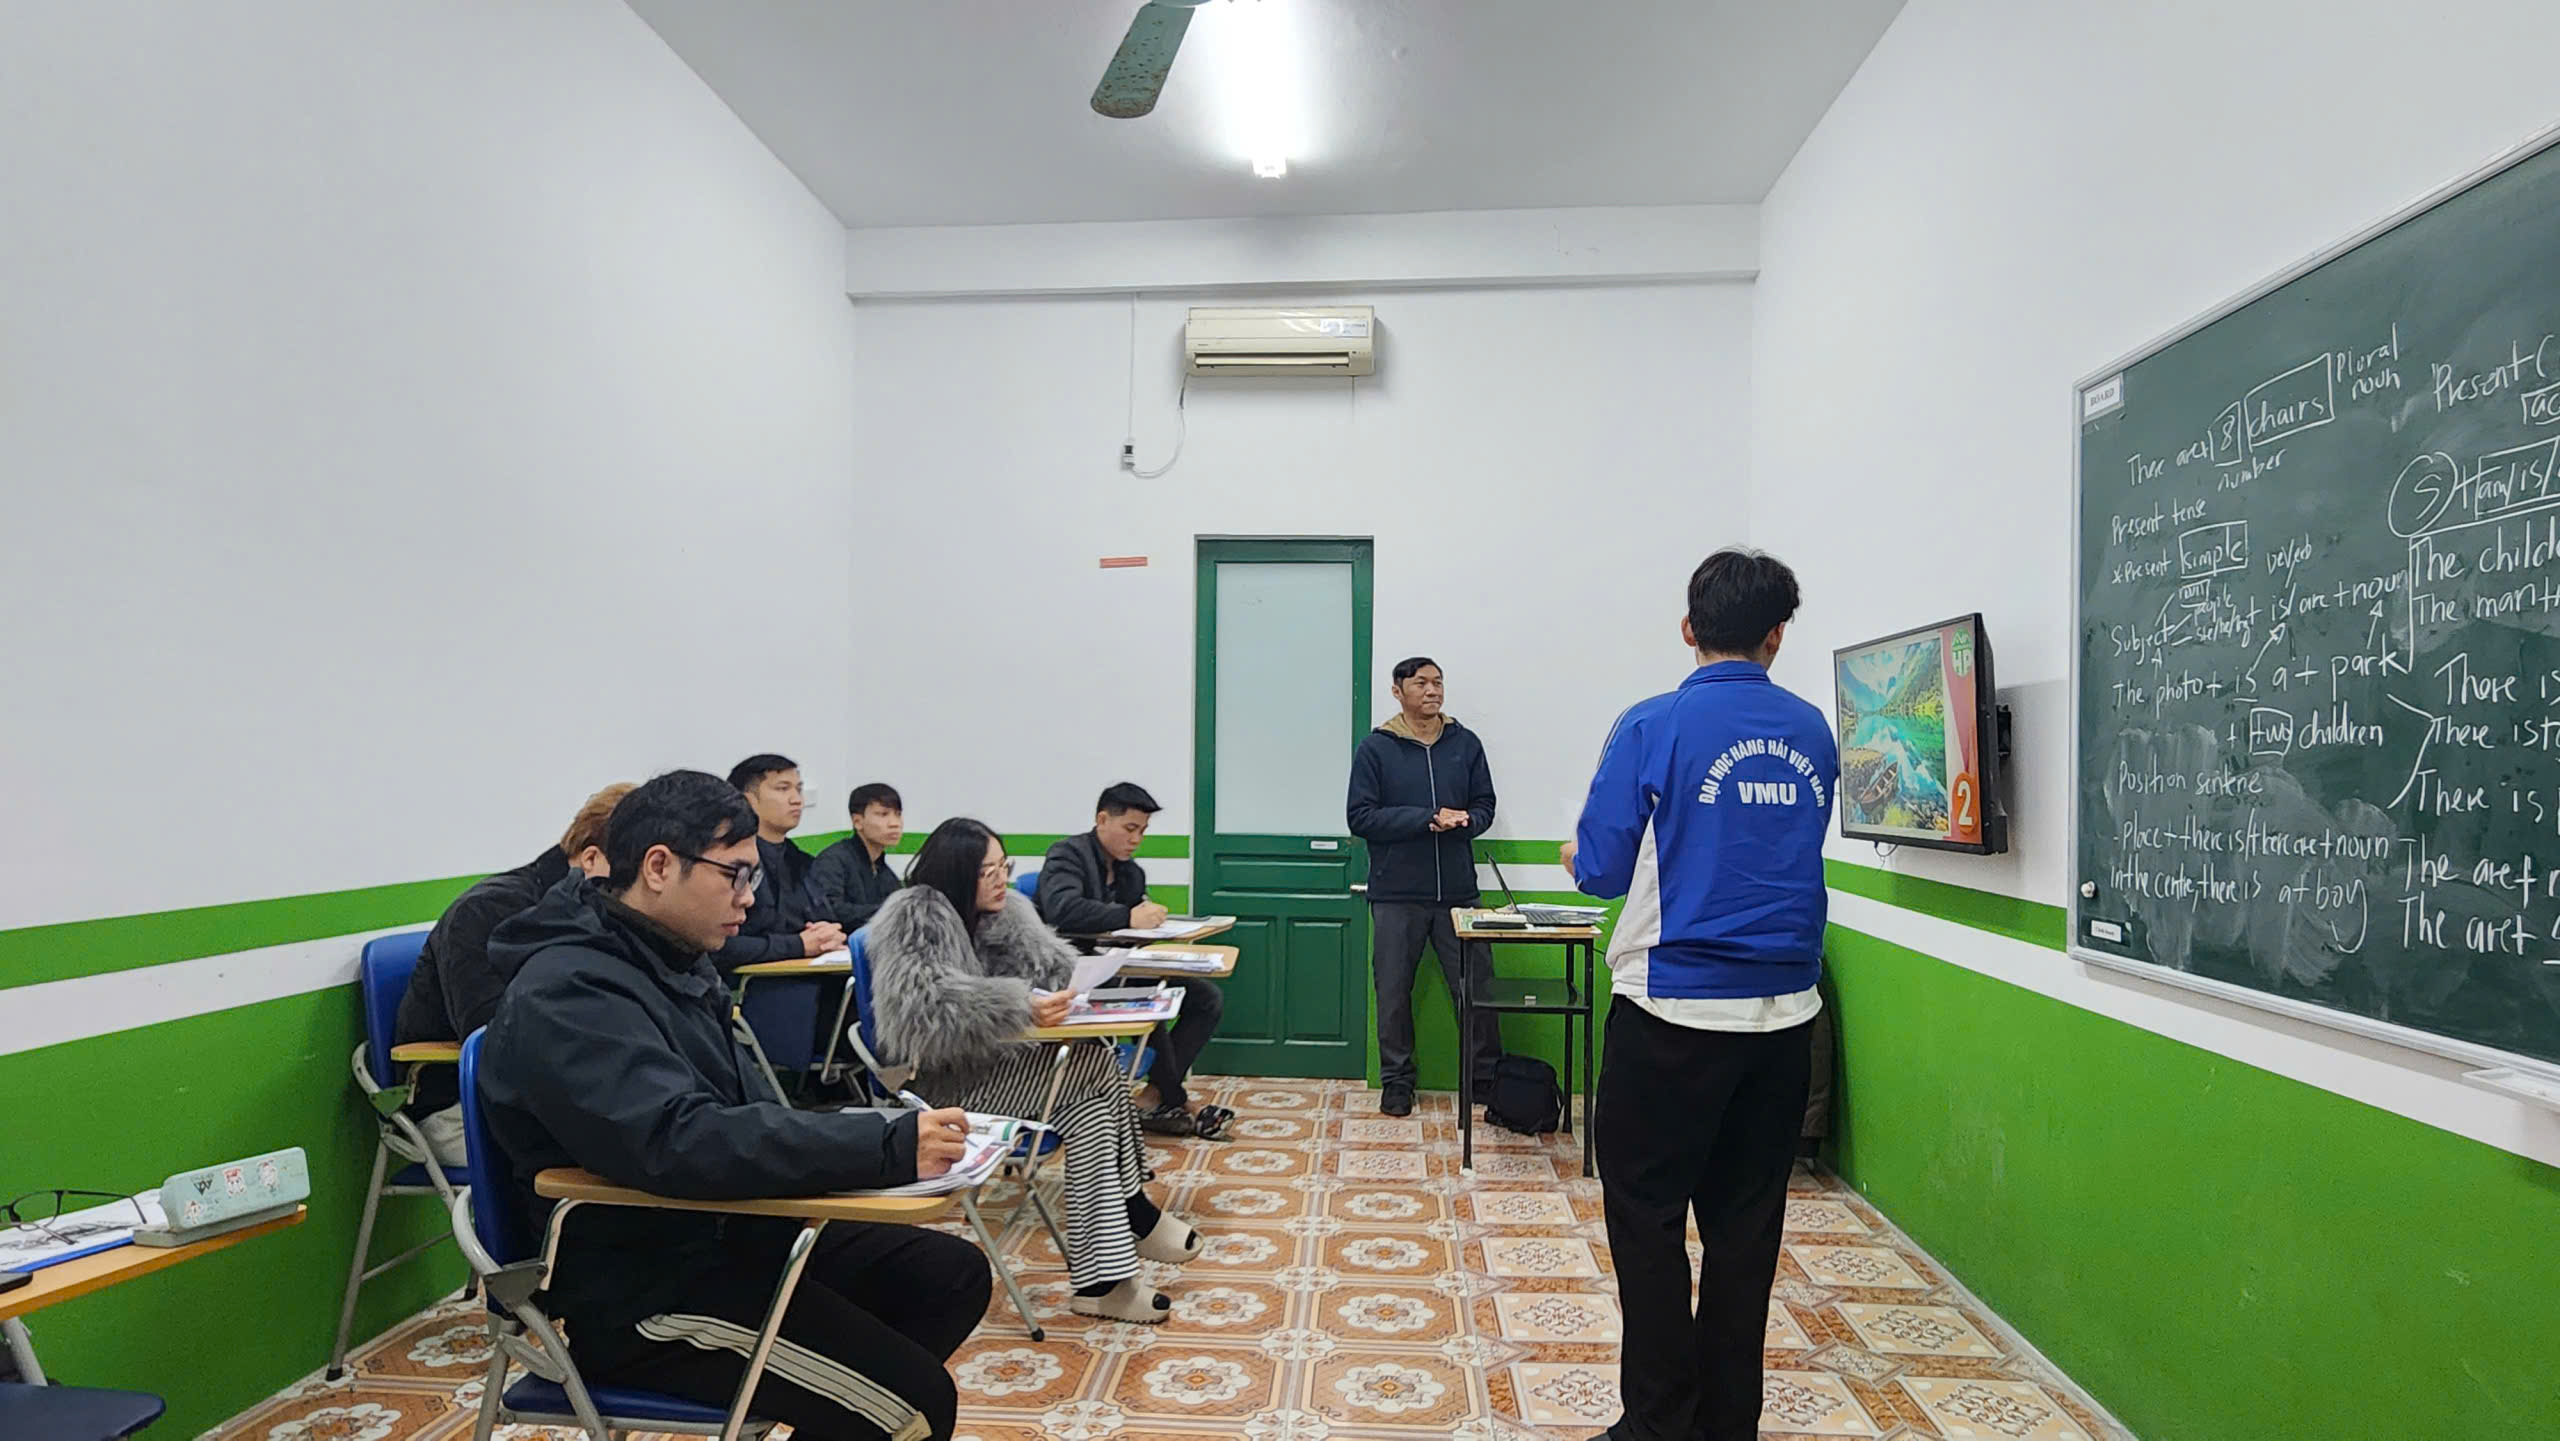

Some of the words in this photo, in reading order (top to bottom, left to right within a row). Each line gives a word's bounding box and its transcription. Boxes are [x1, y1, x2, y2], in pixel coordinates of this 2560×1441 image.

[2249, 398, 2325, 438] chairs
[2217, 448, 2287, 493] number
[2112, 501, 2164, 546] Present
[2172, 498, 2207, 526] tense
[2183, 526, 2245, 577] simple
[2111, 612, 2175, 665] Subject
[2156, 669, 2203, 720] photo
[2331, 632, 2408, 703] park
[2299, 700, 2384, 749] children
[1729, 738, 1766, 762] HÀNG
[1809, 774, 1826, 808] NAM
[1737, 781, 1798, 806] VMU
[1956, 779, 1974, 826] 2
[2335, 834, 2390, 860] noun
[2315, 867, 2368, 954] boy
